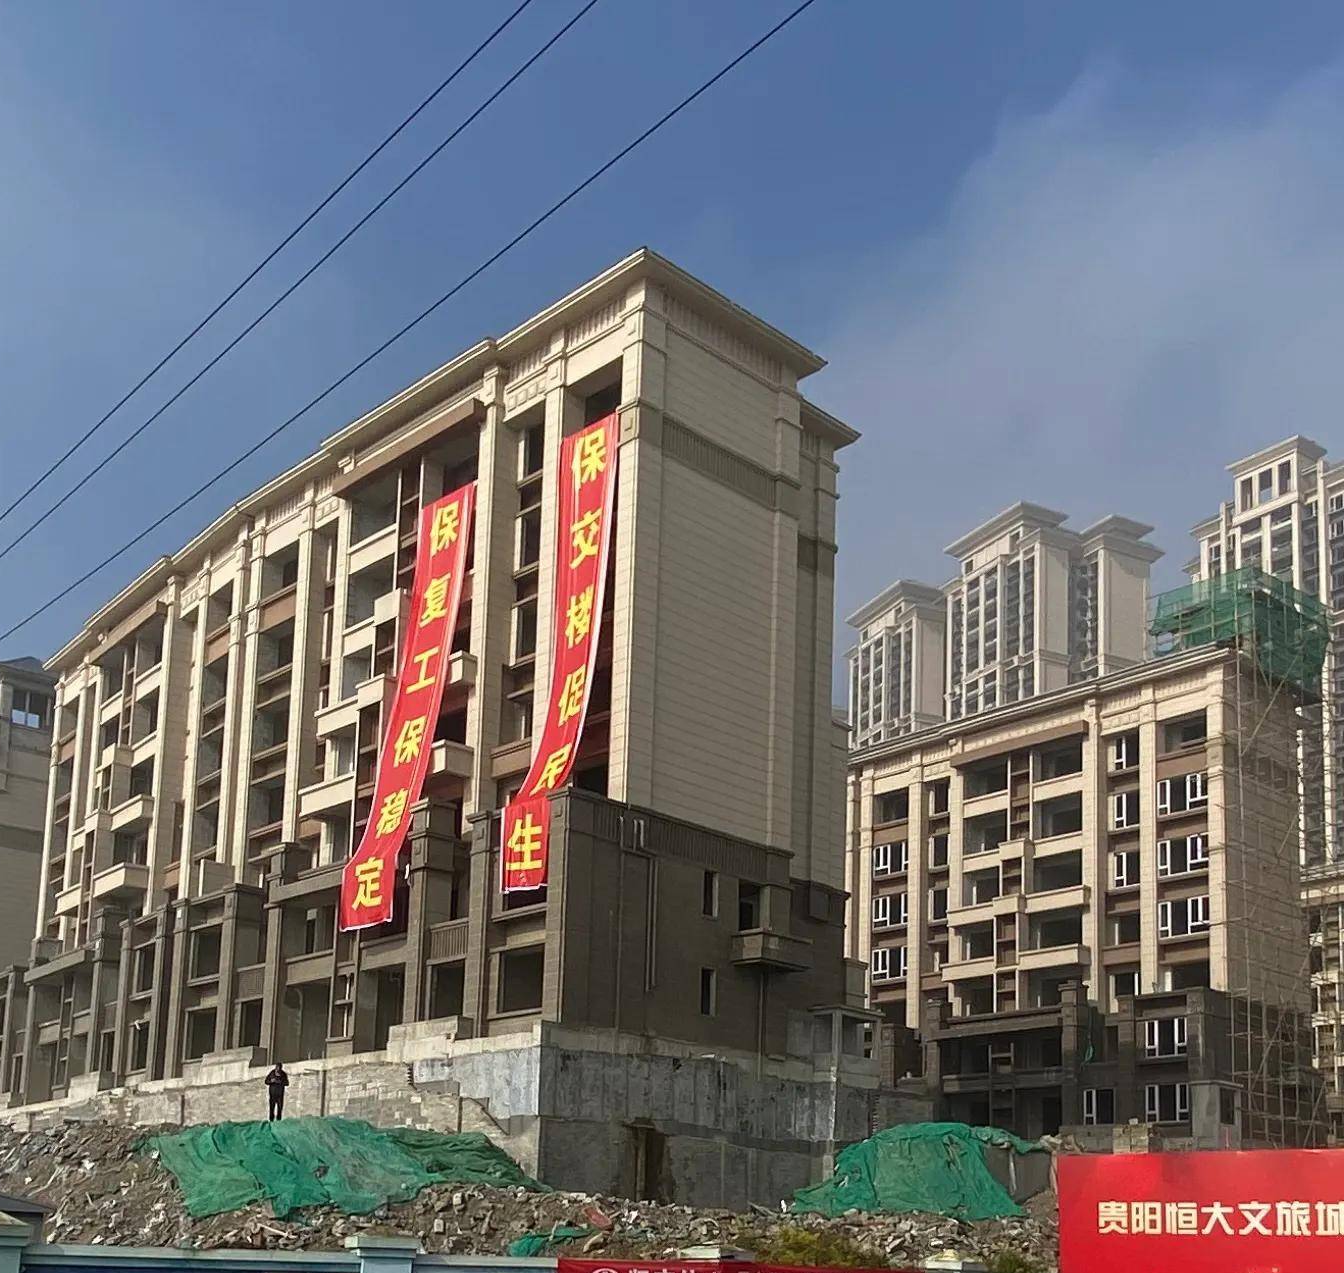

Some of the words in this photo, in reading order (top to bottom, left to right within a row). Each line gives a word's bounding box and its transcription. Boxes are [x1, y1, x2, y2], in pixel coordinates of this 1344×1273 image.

[350, 499, 460, 911] 保复工保稳定
[506, 426, 608, 873] 保交楼促民生
